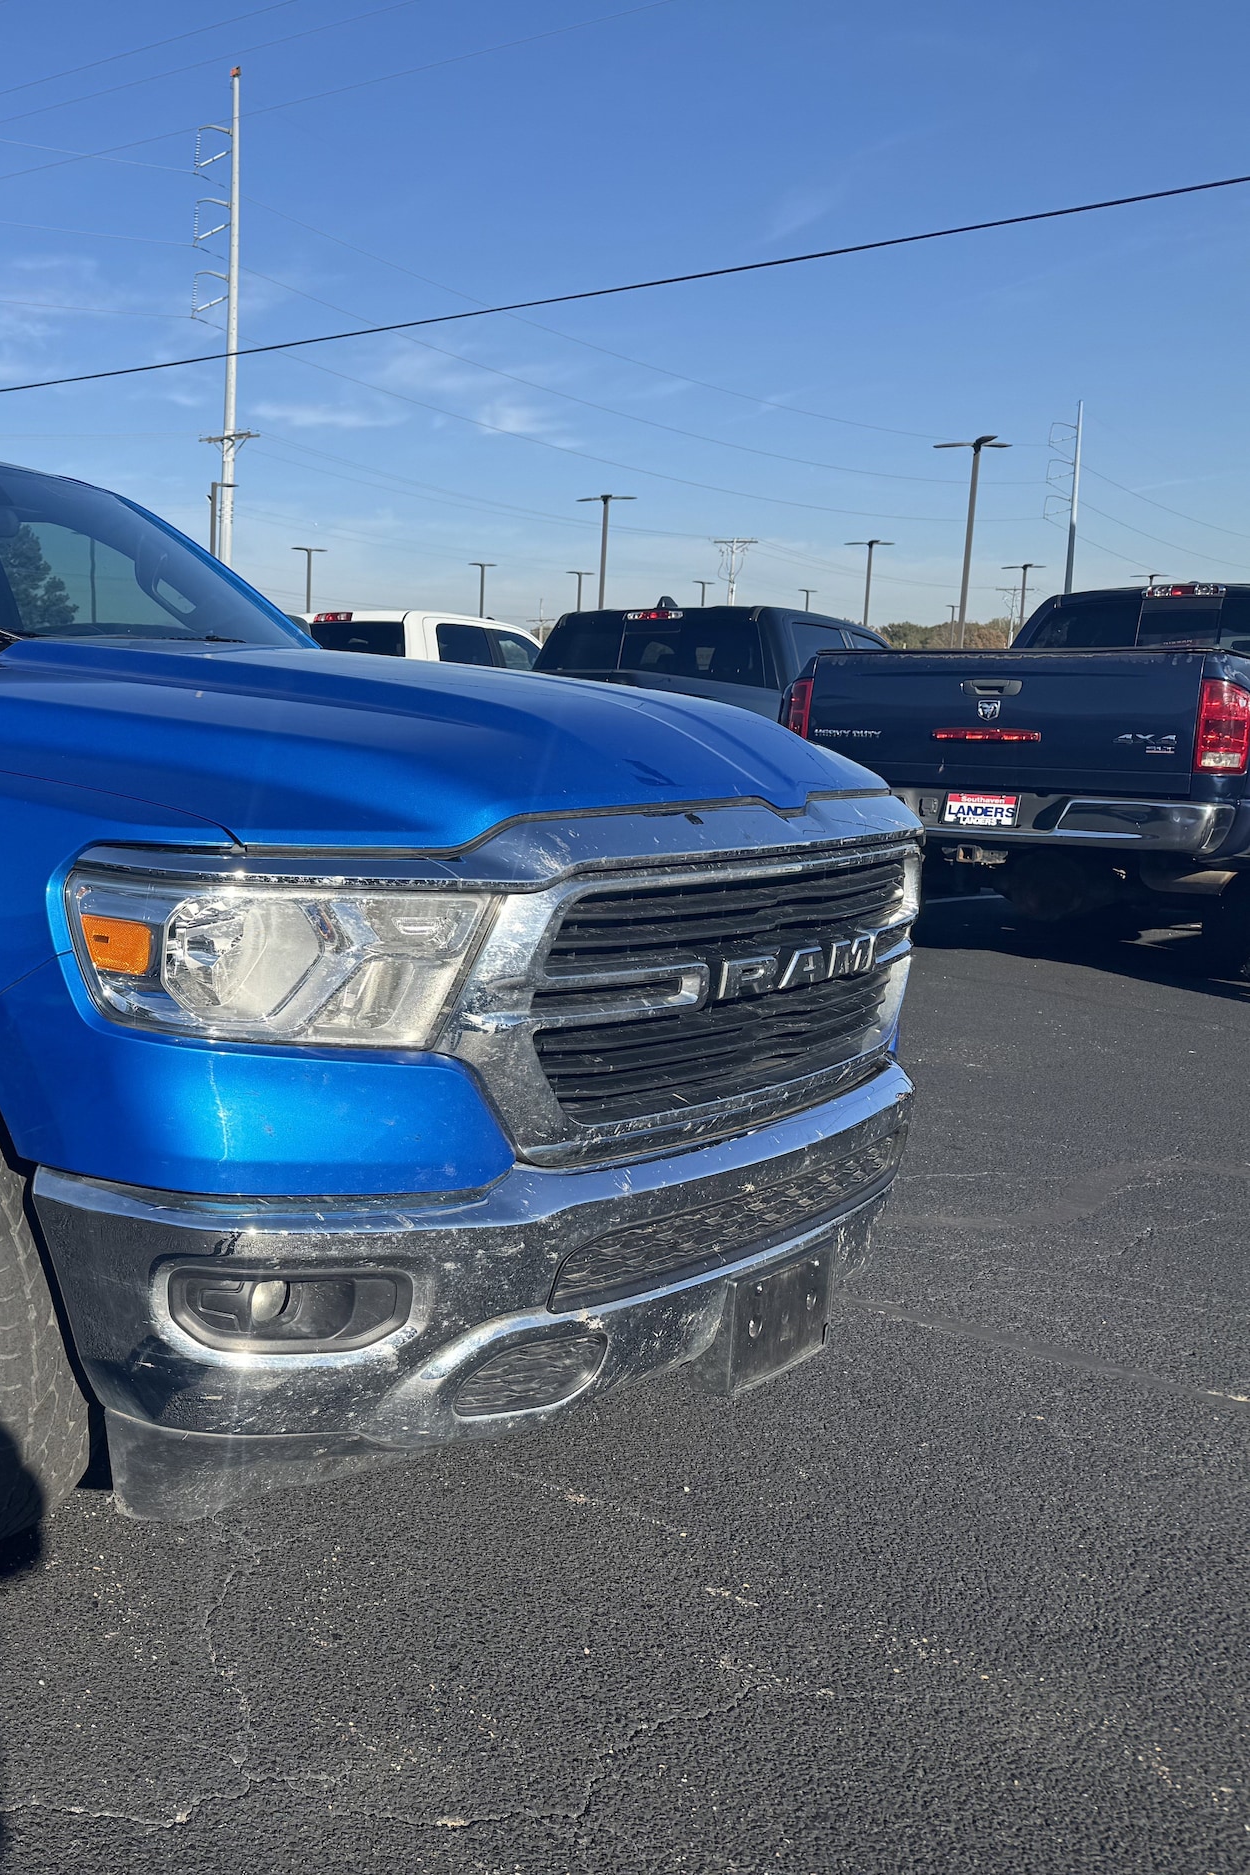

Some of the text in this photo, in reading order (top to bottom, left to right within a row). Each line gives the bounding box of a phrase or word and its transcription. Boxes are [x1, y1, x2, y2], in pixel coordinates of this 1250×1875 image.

[960, 795, 1006, 805] Southaven
[947, 803, 1016, 819] LANDERS
[959, 816, 998, 827] LANDERS
[718, 933, 877, 1000] RAM
